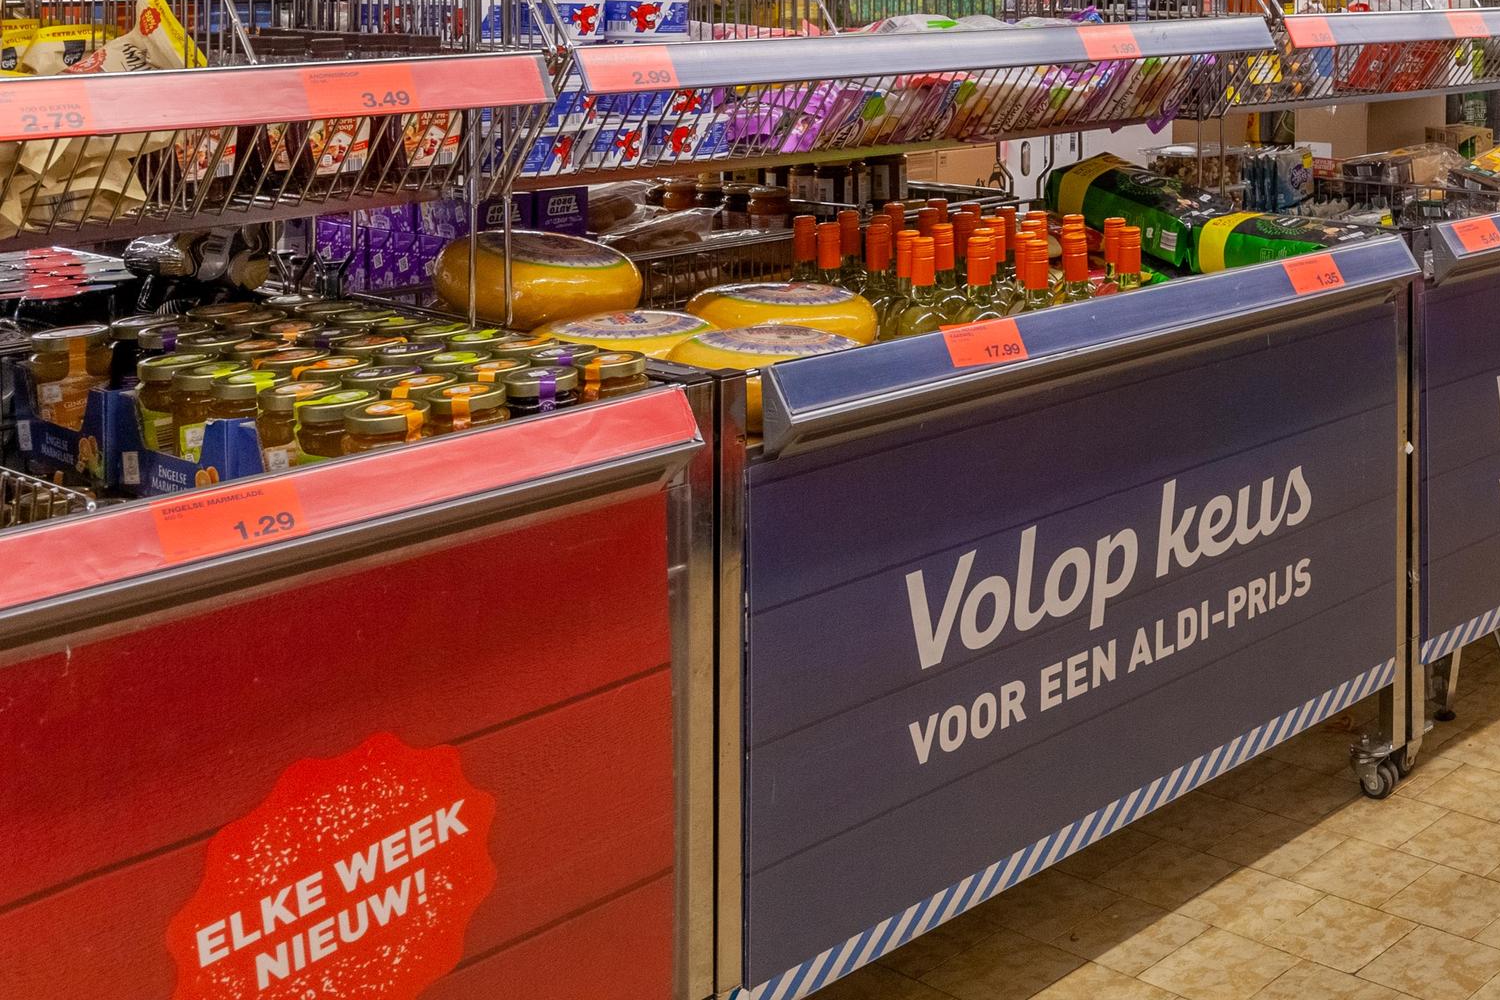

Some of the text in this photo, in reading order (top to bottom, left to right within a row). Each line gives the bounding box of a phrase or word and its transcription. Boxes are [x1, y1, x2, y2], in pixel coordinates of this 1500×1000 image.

[52, 30, 76, 38] EXTRA
[632, 70, 671, 84] 2.99
[361, 90, 411, 108] 3.49
[21, 112, 84, 133] 2.79
[550, 205, 572, 214] AUTO
[551, 196, 573, 206] DROP
[1317, 272, 1340, 286] 1.35
[984, 343, 1020, 358] 17.99
[158, 464, 187, 485] ENGELSE
[162, 489, 264, 515] ENGELSE MARMELADE
[233, 511, 296, 541] 1.29
[906, 465, 1312, 669] Volop keus
[909, 558, 1311, 765] VOOR EEN ALDI-PRIJS
[196, 799, 469, 968] ELKE WEEK
[255, 868, 428, 991] NIEUW!
